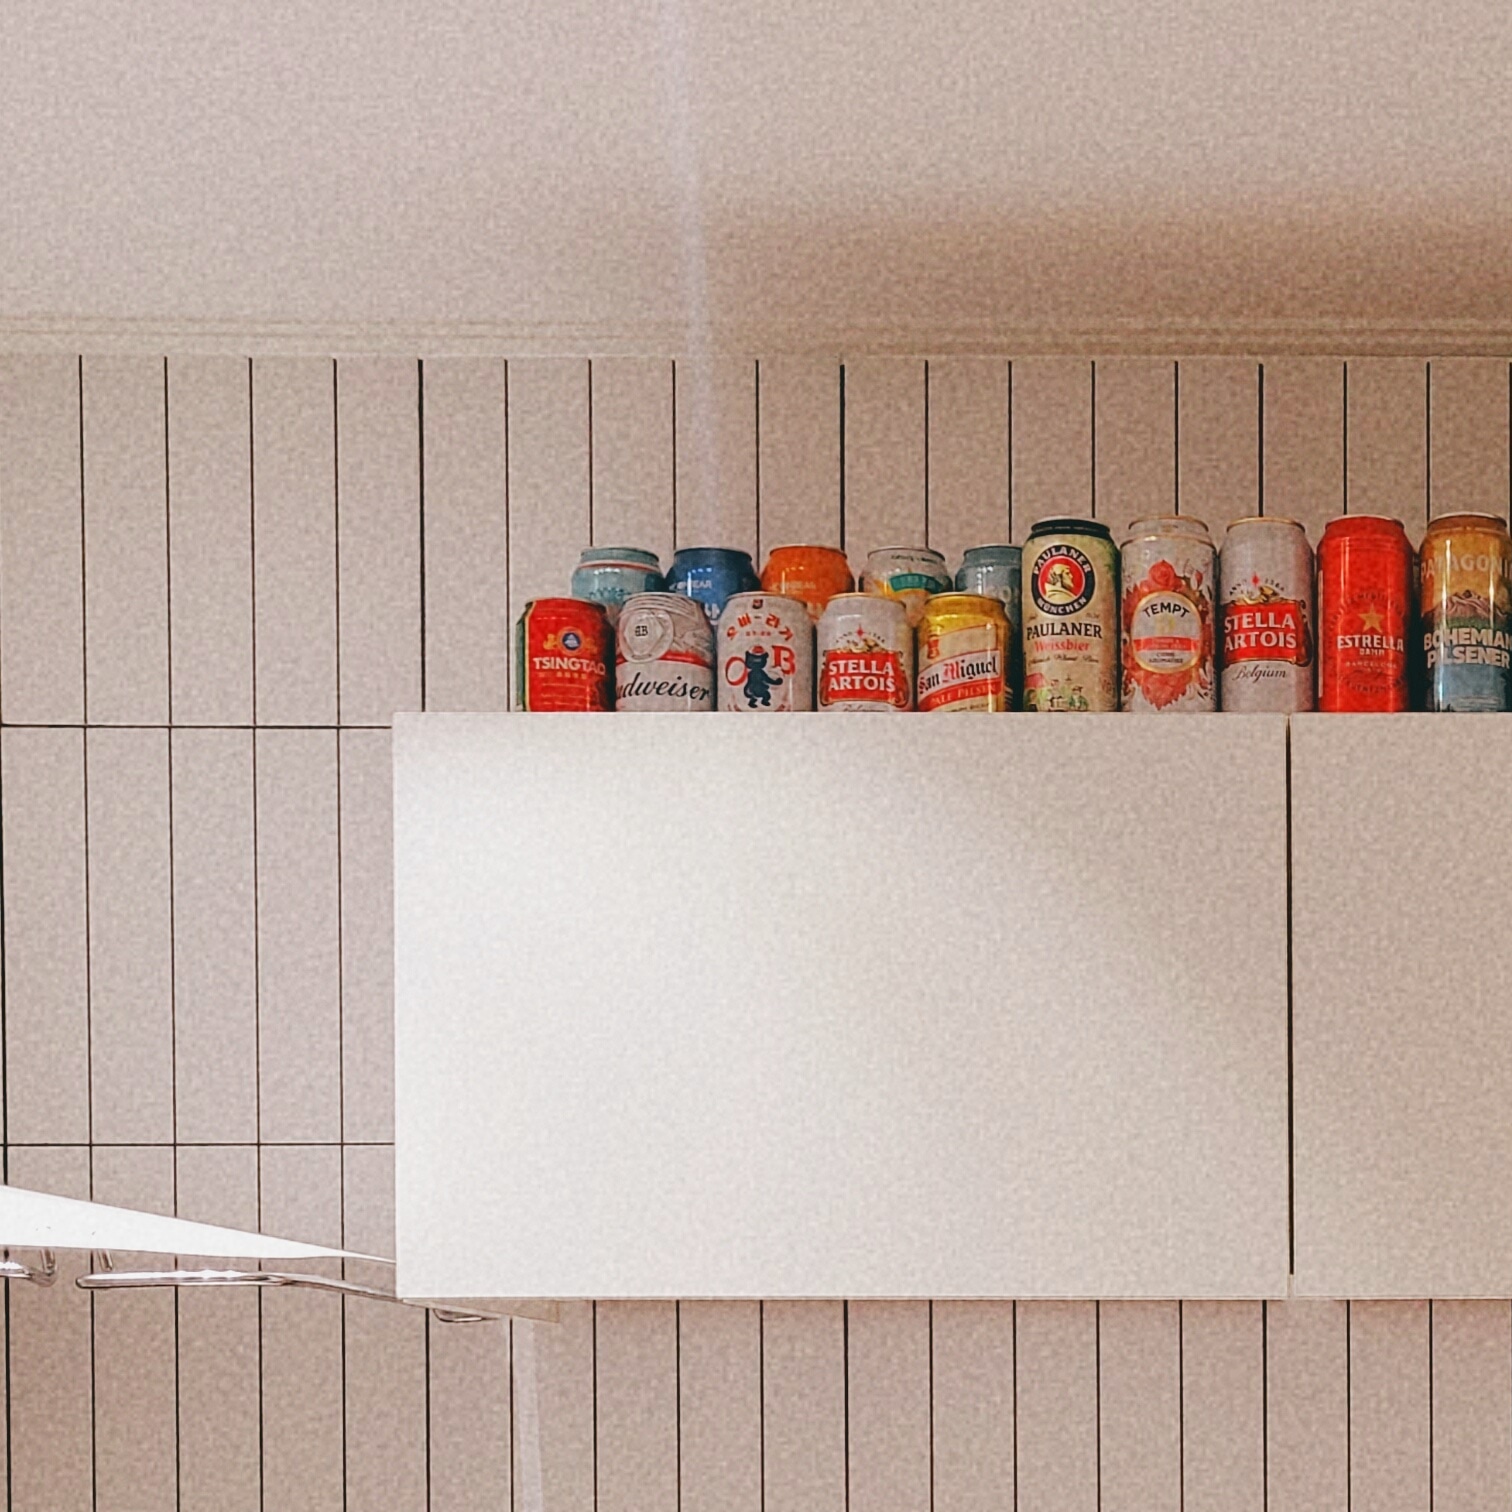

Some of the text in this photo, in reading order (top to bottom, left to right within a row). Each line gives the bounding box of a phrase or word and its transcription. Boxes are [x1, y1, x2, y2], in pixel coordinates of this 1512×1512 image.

[1033, 545, 1092, 575] PAULANER
[1143, 602, 1190, 618] TEMPT
[1027, 622, 1103, 641] PAULANER
[1224, 612, 1296, 633] STELLA
[1033, 639, 1091, 653] Weissbier
[1224, 631, 1297, 652] ARTOIS
[1337, 635, 1404, 652] ESTRELLA
[1423, 627, 1512, 651] BOHEMIAN
[532, 656, 607, 676] TSINGTAO
[1427, 646, 1511, 669] PILSENER
[828, 659, 896, 677] STELLA
[919, 656, 999, 695] San Miguel
[1231, 664, 1287, 684] Belgium
[828, 675, 896, 693] ARTOIS
